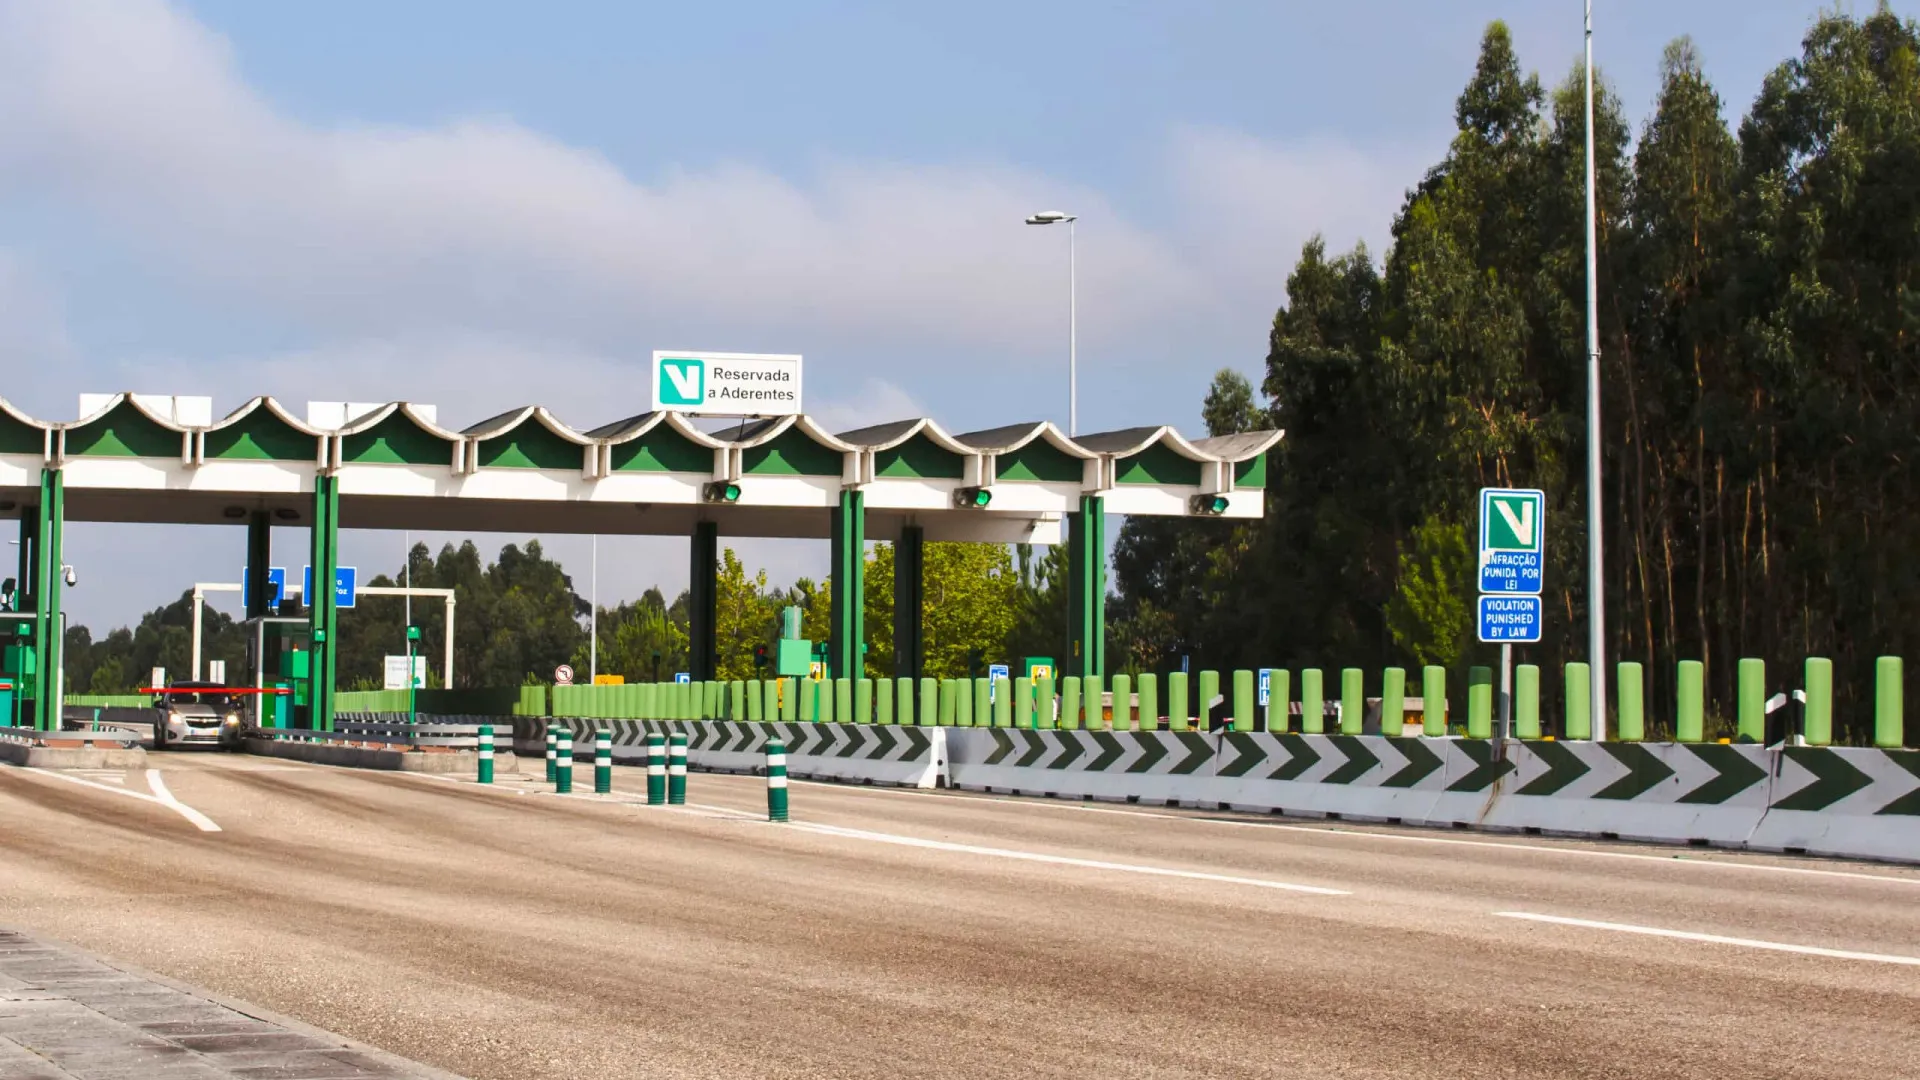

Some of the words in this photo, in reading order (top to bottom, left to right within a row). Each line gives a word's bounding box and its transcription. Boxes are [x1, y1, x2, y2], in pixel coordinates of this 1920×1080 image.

[713, 367, 790, 382] Reservada
[708, 388, 716, 398] a
[720, 387, 794, 400] Aderentes
[1484, 568, 1517, 578] PUNIDA
[1522, 568, 1539, 579] POR
[1505, 580, 1518, 590] LEI
[1486, 600, 1534, 611] VIOLATION
[1486, 613, 1534, 624] PUNISHED
[1491, 626, 1503, 637] BY
[1509, 626, 1528, 637] LAW
